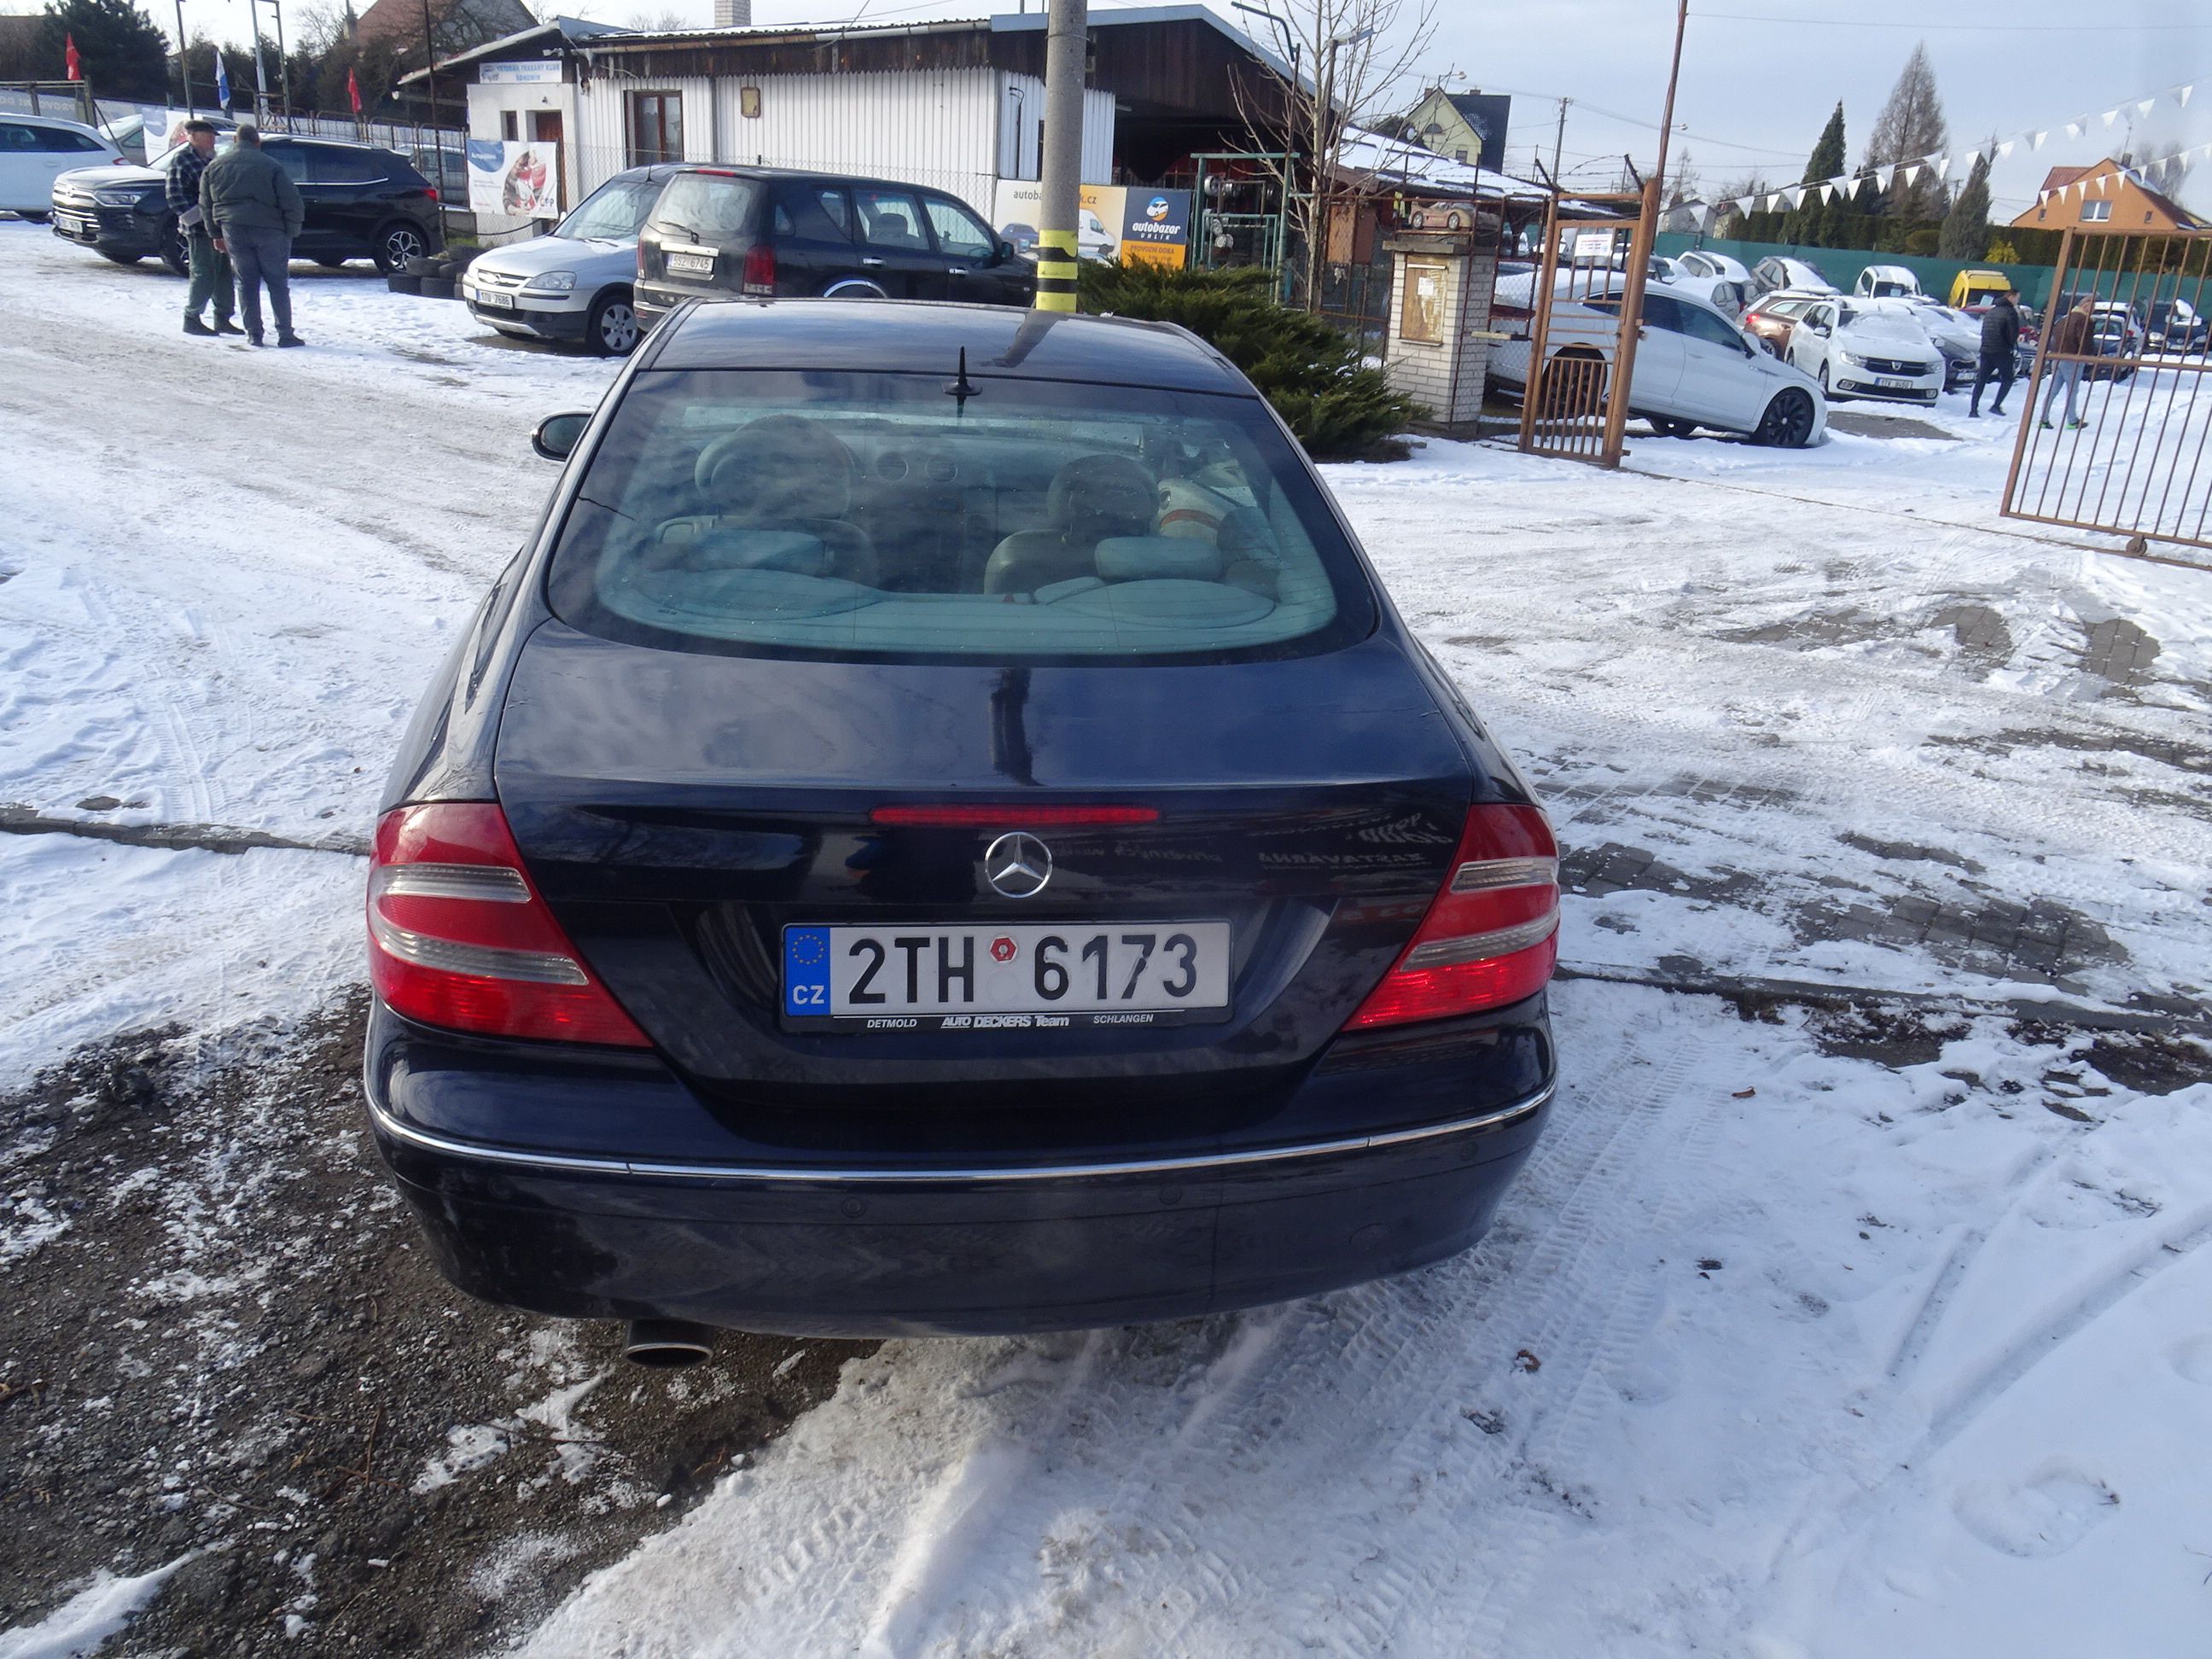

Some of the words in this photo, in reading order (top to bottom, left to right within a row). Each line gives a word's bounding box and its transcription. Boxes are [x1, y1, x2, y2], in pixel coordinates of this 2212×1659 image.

[1132, 221, 1181, 235] autobazar
[848, 935, 975, 1005] 2TH
[1033, 933, 1197, 1001] 6173
[792, 985, 824, 1004] CZ
[866, 1018, 917, 1028] DETMOLD
[940, 1016, 972, 1028] AUTO
[973, 1016, 1033, 1027] DECKERS
[1034, 1015, 1069, 1027] Team
[1093, 1014, 1154, 1024] SCHLANGEN
